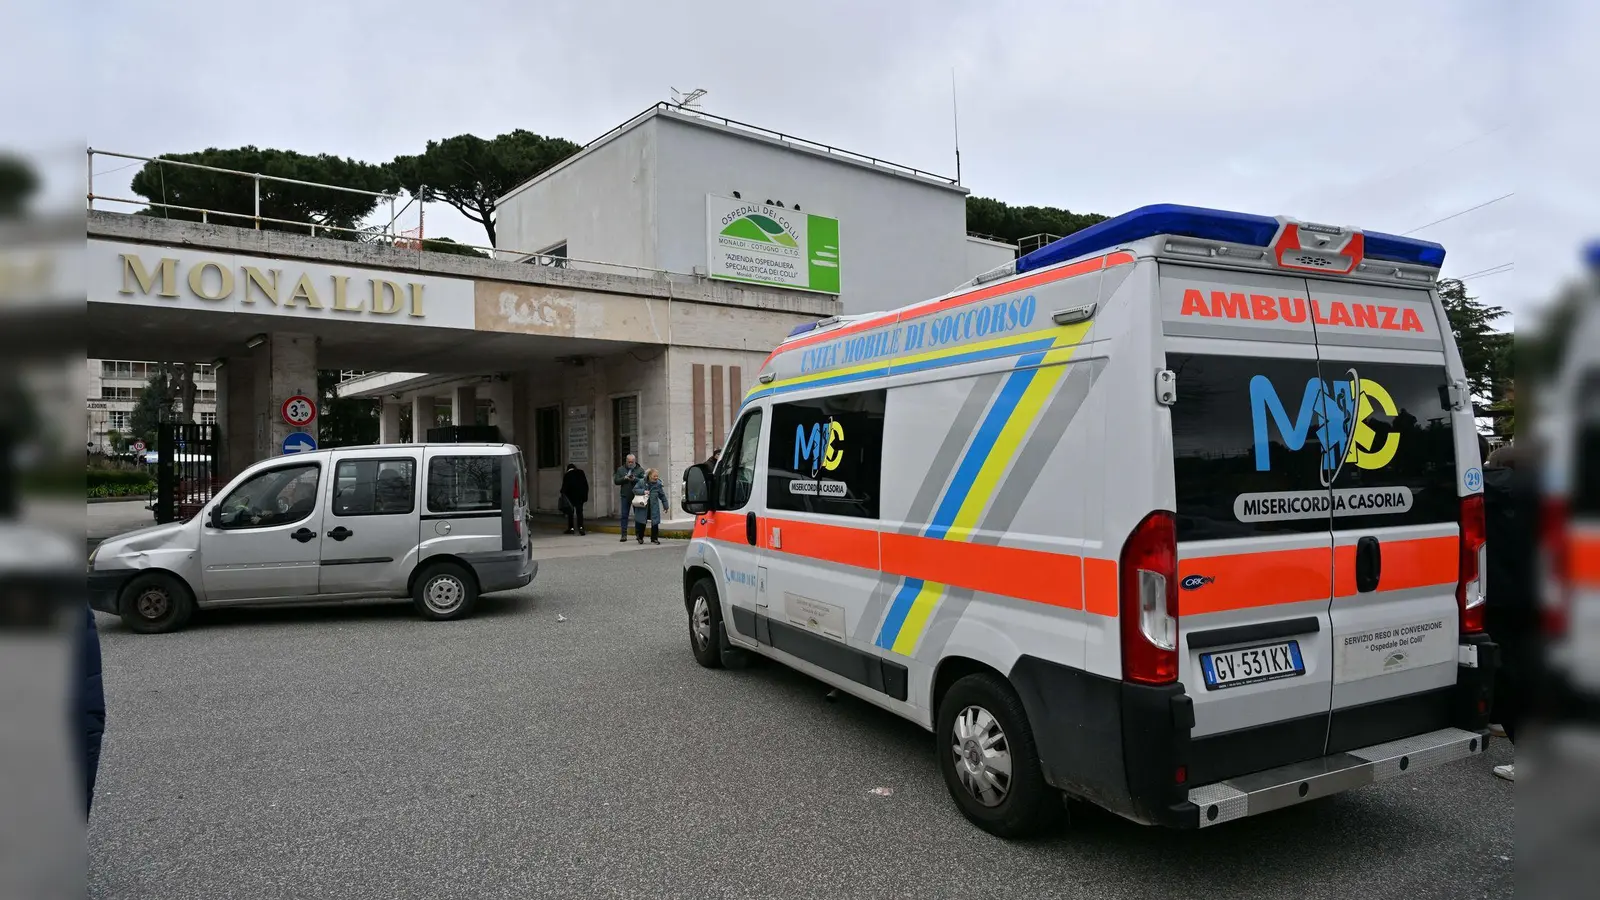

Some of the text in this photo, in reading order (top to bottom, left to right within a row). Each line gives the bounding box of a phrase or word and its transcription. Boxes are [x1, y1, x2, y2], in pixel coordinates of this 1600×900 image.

[721, 206, 799, 240] OSPEDALI DEI COLLI
[719, 238, 746, 247] MONALDI
[751, 243, 779, 253] COTUGNO
[725, 262, 768, 274] SPECIALISTICA
[769, 267, 779, 276] DEI
[755, 258, 794, 269] OSPEDALIERA
[118, 253, 425, 318] MONALDI
[1180, 288, 1425, 333] AMBULANZA
[841, 327, 902, 364] MOBILE
[904, 324, 925, 351] DI
[928, 294, 1036, 347] SOCCORSO
[823, 484, 844, 493] CASORIA
[1467, 472, 1480, 486] 29
[1243, 492, 1406, 516] MISERICORDIA CASORIA
[1344, 621, 1442, 646] SERVIZIO RESO IN CONVENZIONE
[1400, 637, 1409, 646] Dei
